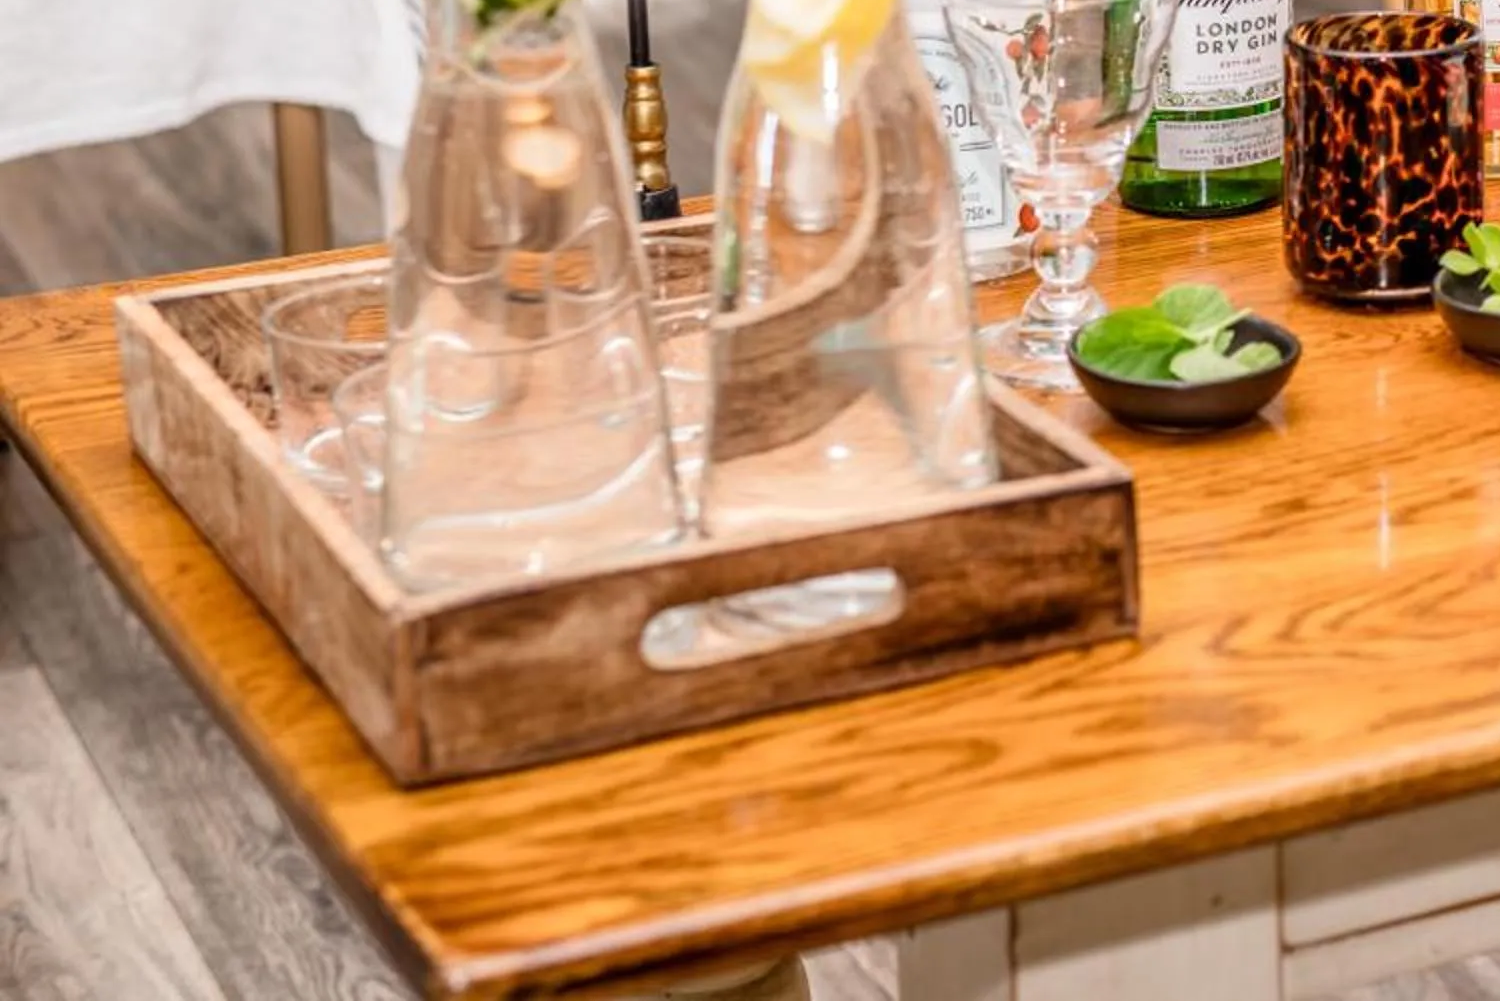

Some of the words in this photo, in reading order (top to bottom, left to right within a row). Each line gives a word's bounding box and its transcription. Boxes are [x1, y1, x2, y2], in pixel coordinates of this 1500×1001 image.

[1195, 12, 1279, 38] LONDON
[1196, 40, 1240, 56] DRY
[1247, 30, 1278, 50] GIN
